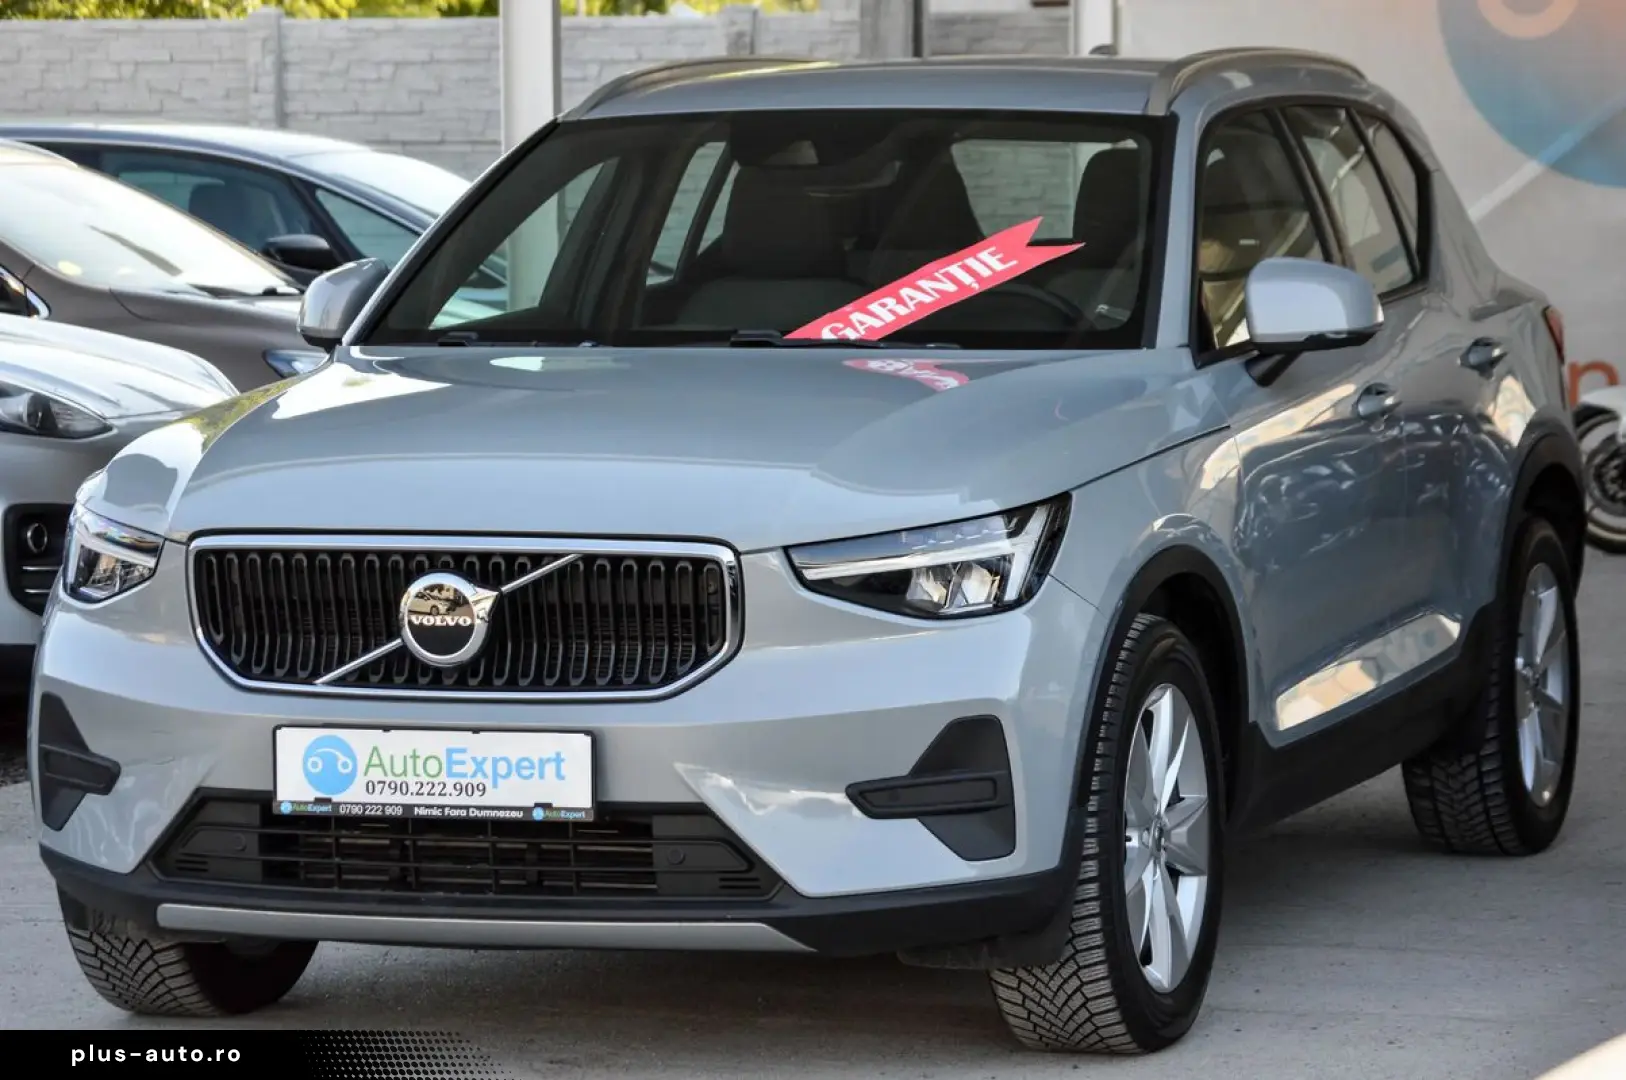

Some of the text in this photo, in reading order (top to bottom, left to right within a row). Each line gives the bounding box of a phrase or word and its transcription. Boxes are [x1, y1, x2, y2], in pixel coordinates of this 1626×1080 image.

[410, 614, 472, 627] VOLVO
[363, 744, 566, 789] AutoExpert
[365, 780, 487, 797] 0790.222.909
[340, 803, 363, 815] 0790
[364, 805, 382, 815] 222
[384, 805, 403, 816] 909
[414, 806, 443, 817] Nimic
[444, 807, 467, 817] Fara
[468, 807, 524, 819] Dumnezeu
